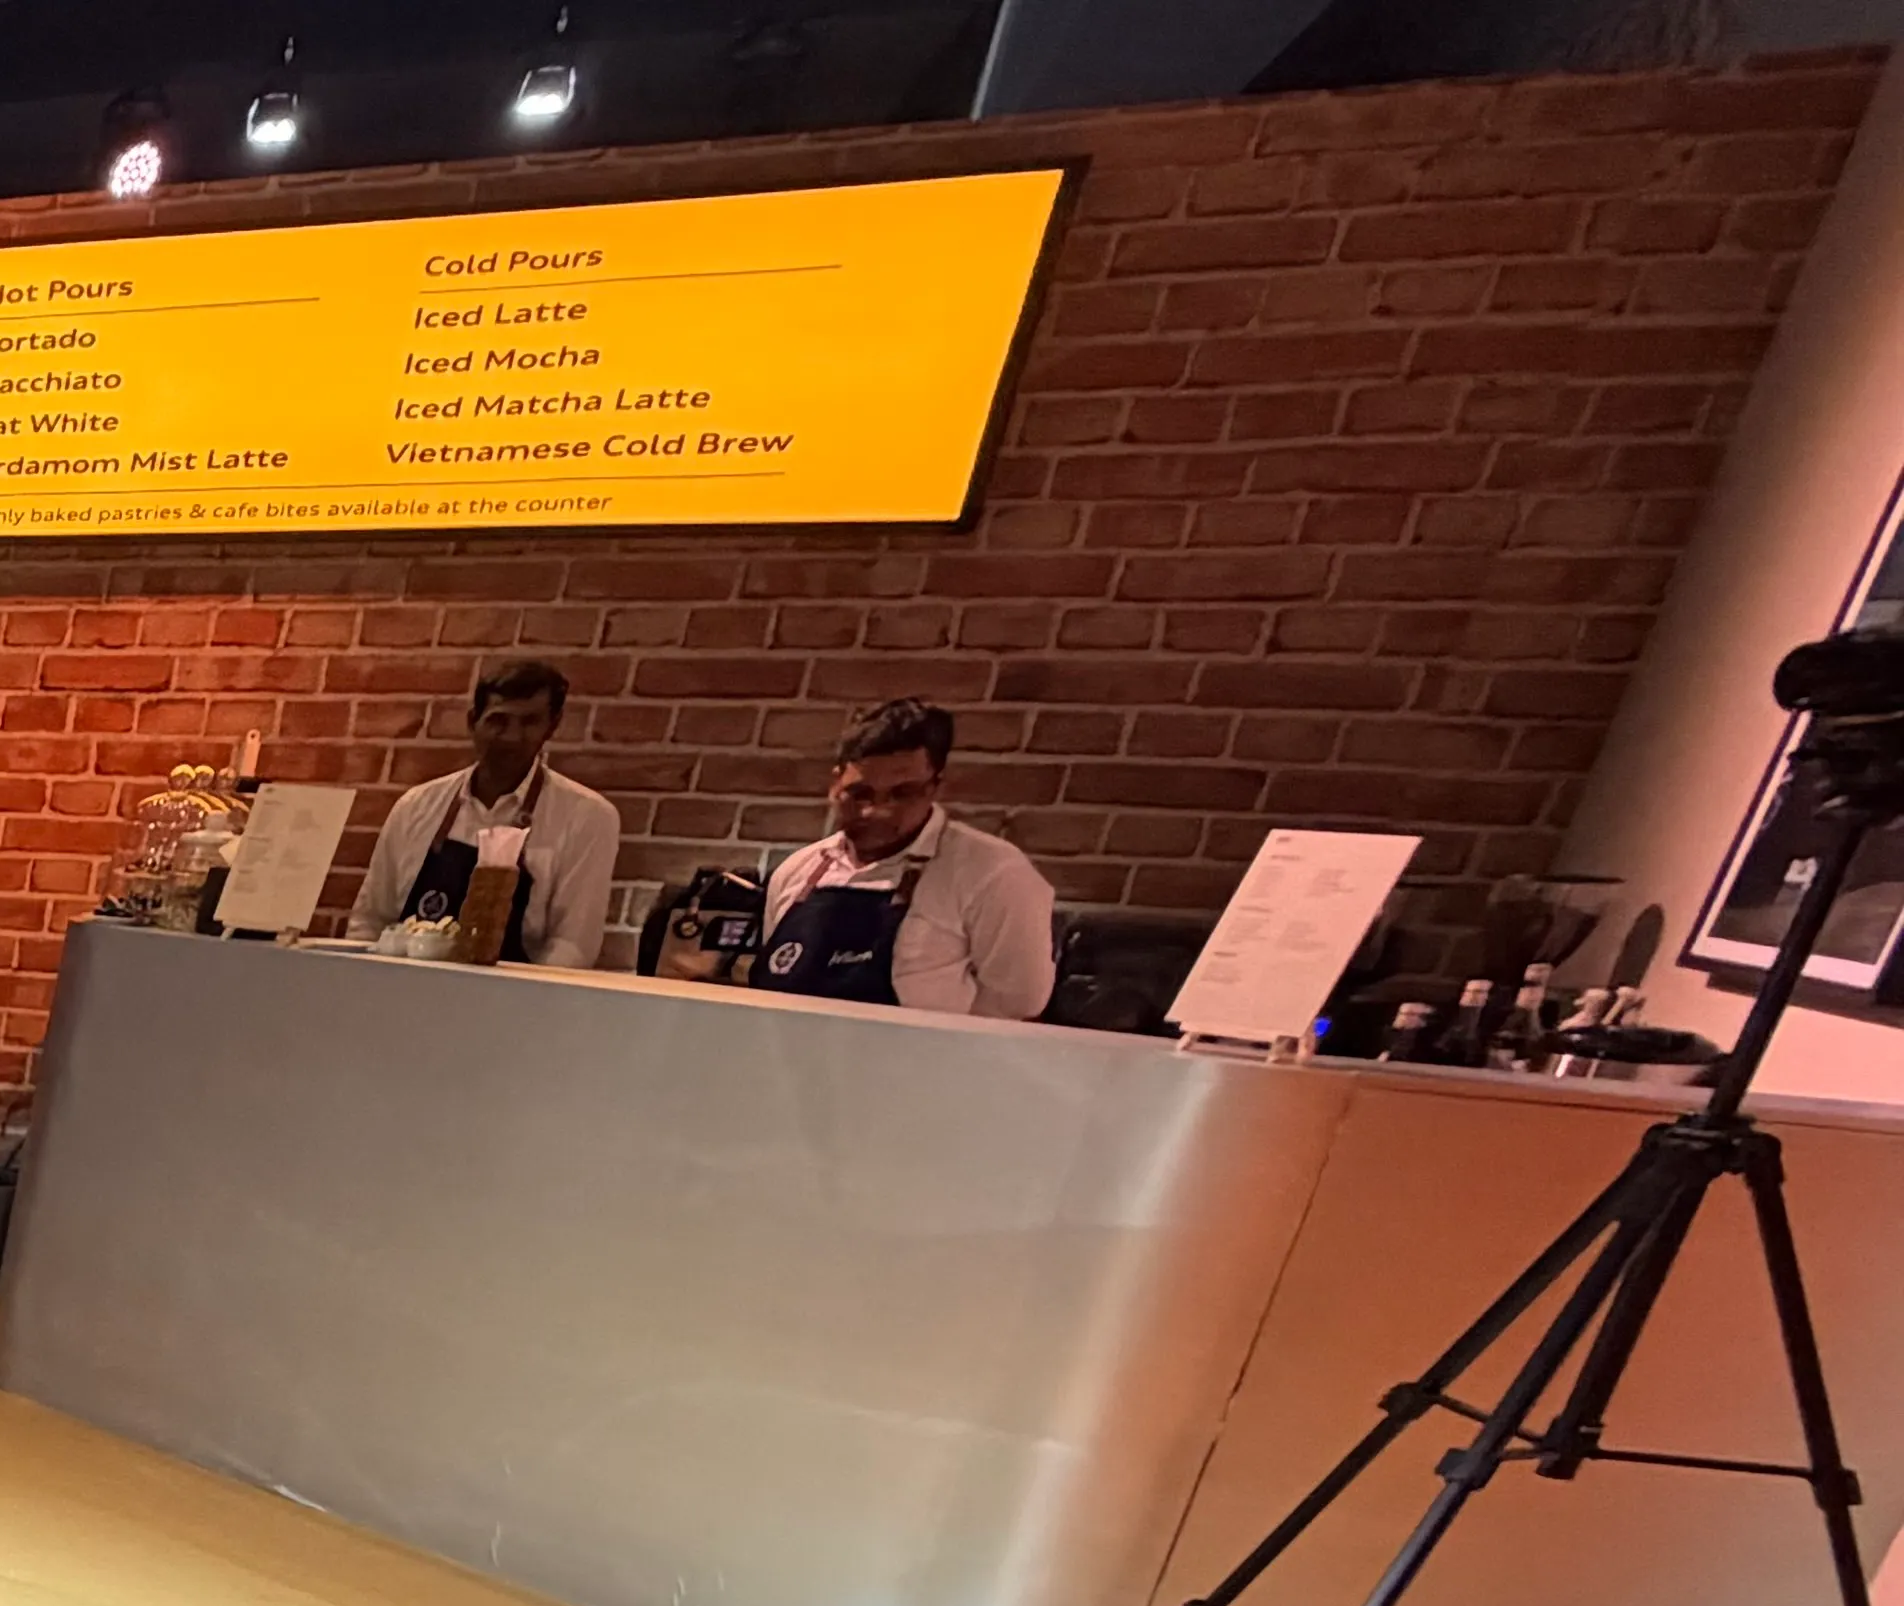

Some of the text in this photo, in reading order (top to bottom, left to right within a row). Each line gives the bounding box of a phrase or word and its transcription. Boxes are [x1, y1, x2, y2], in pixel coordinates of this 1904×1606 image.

[424, 250, 603, 277] Cold Pours
[47, 280, 134, 301] Pours
[414, 302, 588, 329] Iced Latte
[404, 345, 600, 375] Iced Mocha
[394, 388, 711, 421] Iced Matcha Latte
[30, 412, 119, 433] White
[130, 451, 198, 473] Mist
[207, 449, 289, 470] Latte
[386, 432, 794, 464] Vietnamese Cold Brew
[30, 507, 93, 523] baked
[97, 505, 183, 525] pastries
[188, 503, 207, 519] &
[212, 502, 259, 519] cafe
[265, 502, 320, 518] bites
[327, 499, 430, 517] available
[436, 500, 460, 515] at
[469, 497, 508, 514] the
[515, 496, 613, 513] counter
